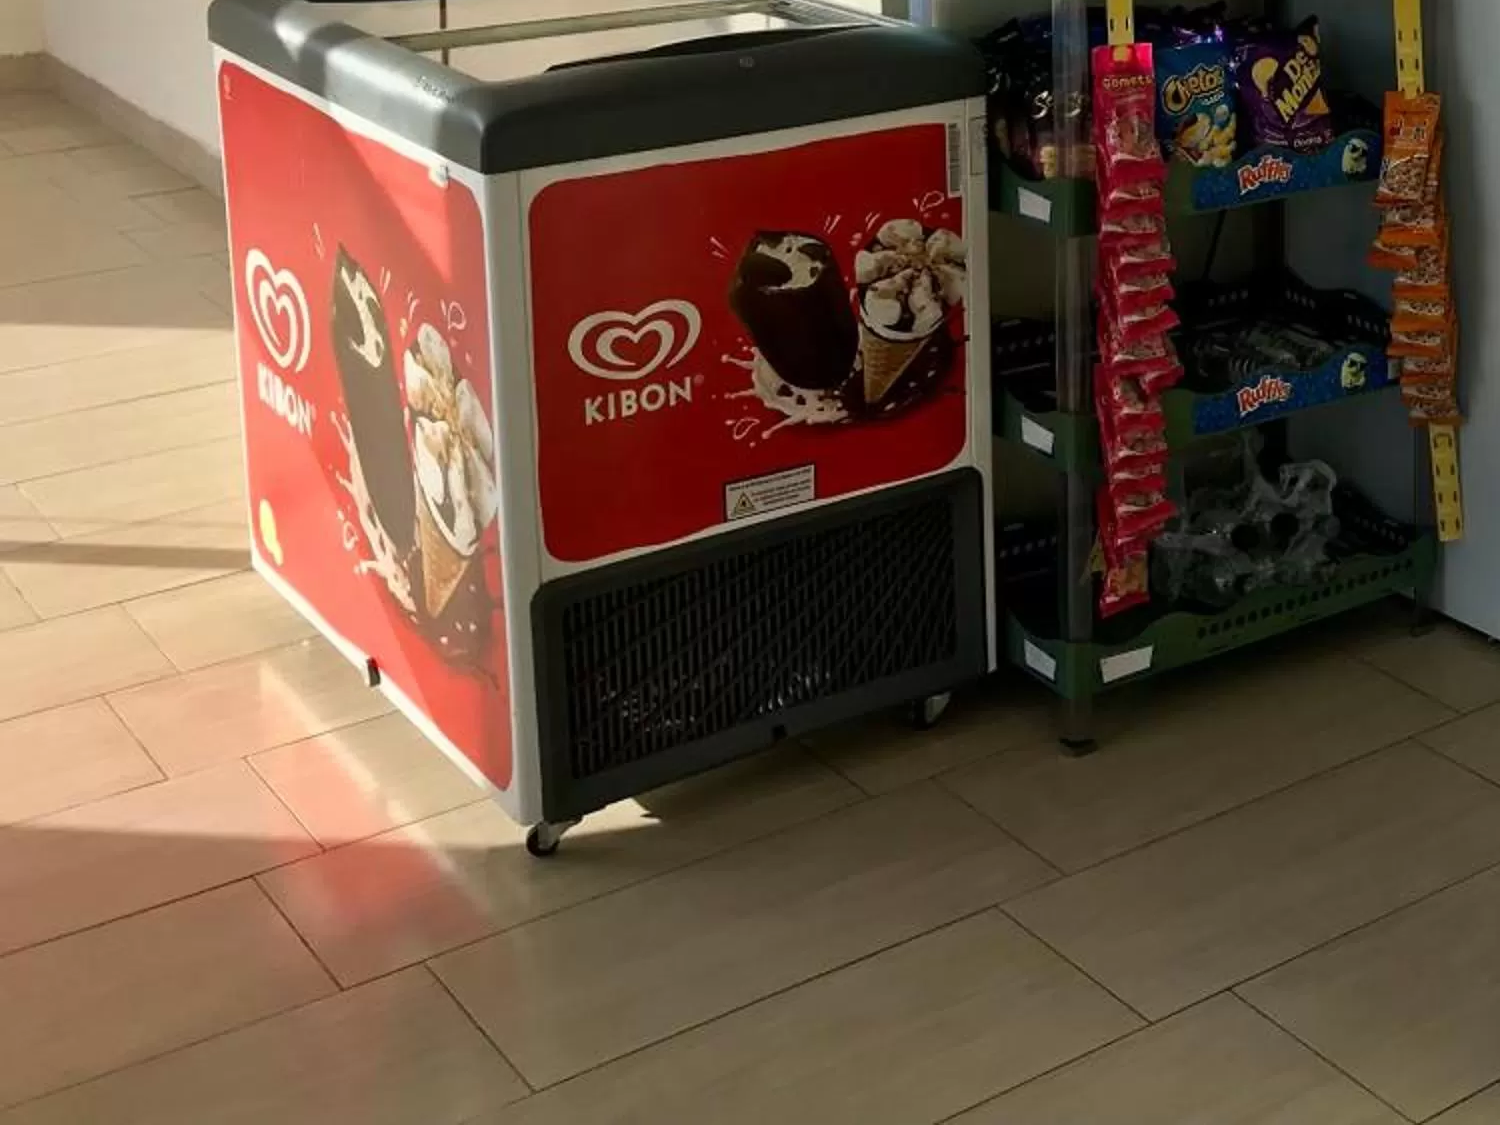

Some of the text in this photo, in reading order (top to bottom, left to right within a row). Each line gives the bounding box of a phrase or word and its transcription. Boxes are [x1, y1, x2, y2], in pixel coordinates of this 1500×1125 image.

[1236, 155, 1294, 196] Ruffles
[256, 362, 312, 436] KIBON
[583, 375, 694, 426] KIBON
[1236, 375, 1295, 418] Ruffles
